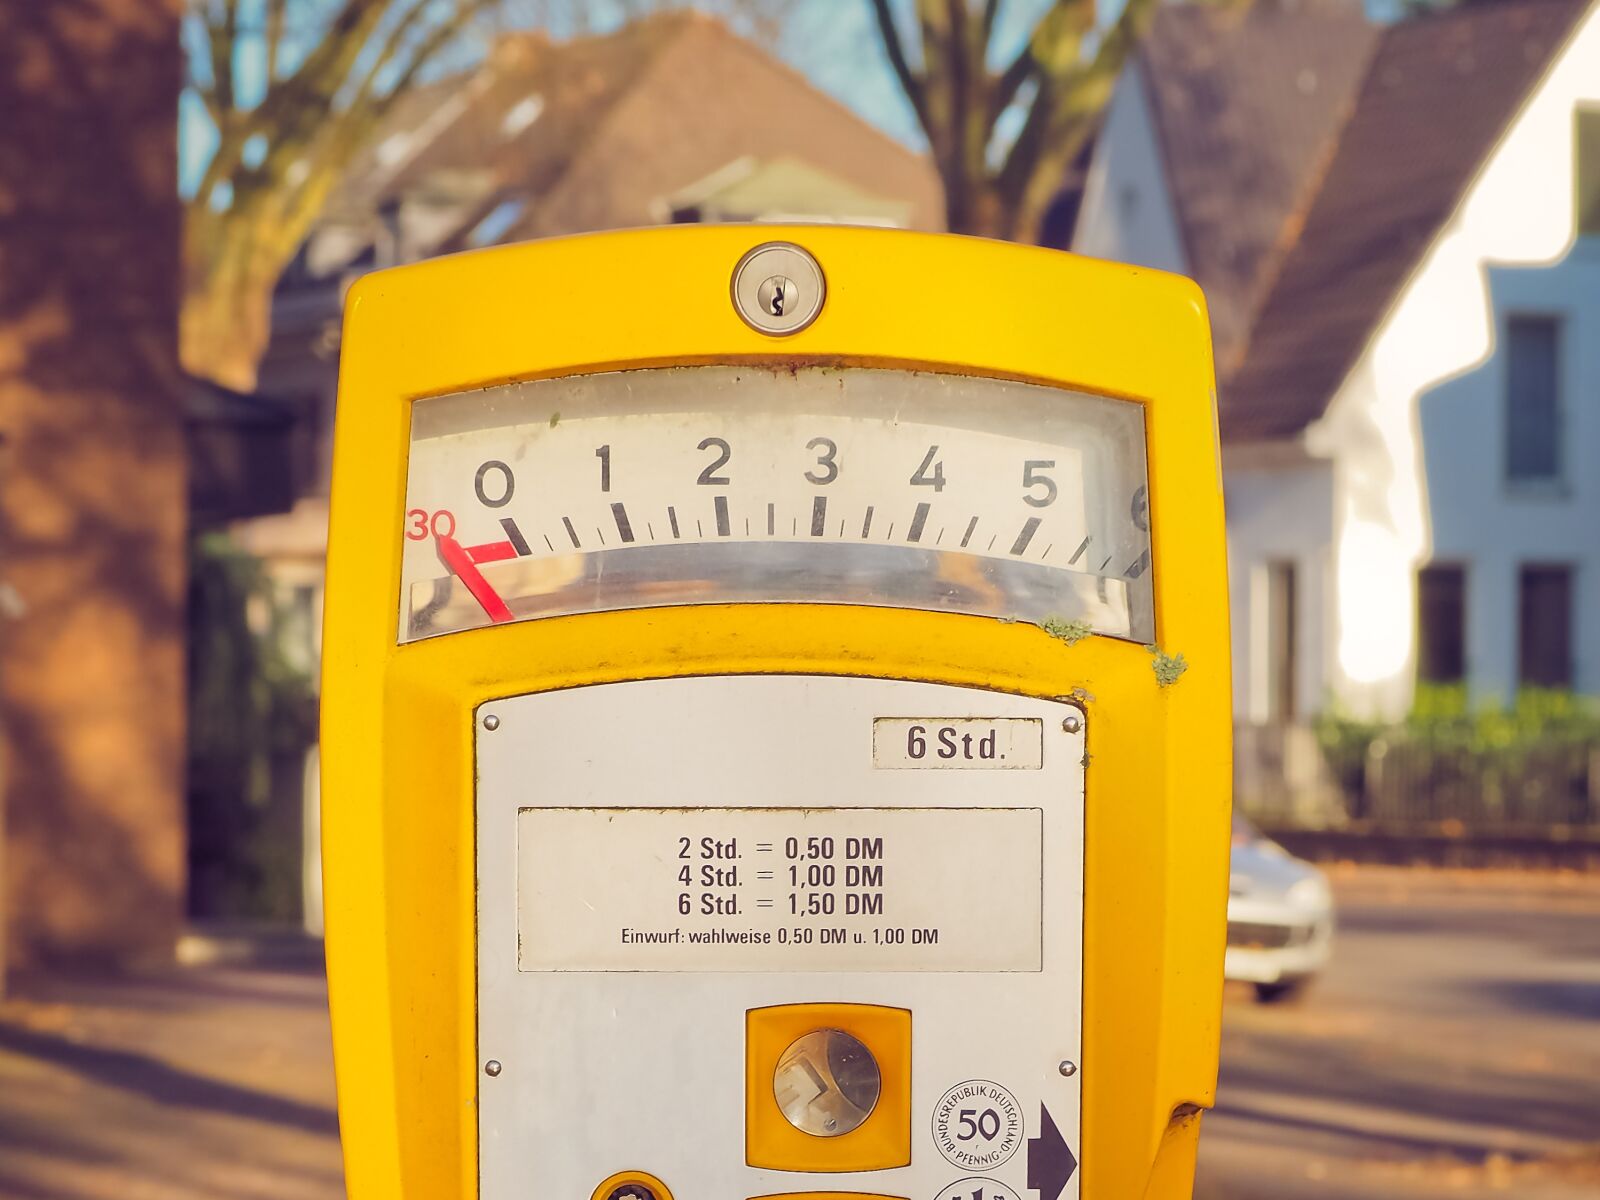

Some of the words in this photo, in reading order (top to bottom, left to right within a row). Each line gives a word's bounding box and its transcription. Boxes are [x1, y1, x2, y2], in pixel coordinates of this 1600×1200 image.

[406, 508, 456, 540] 30
[474, 460, 515, 509] 0
[595, 444, 611, 492] 1
[696, 437, 732, 485] 2
[803, 437, 839, 485] 3
[909, 444, 946, 493] 4
[1022, 460, 1058, 508] 5
[907, 725, 927, 760] 6
[937, 726, 1006, 760] Std.
[678, 836, 692, 860] 2
[700, 836, 743, 861] Std.
[785, 836, 835, 862] 0,50
[845, 837, 883, 860] DM
[678, 864, 693, 887] 4
[700, 864, 743, 888] Std.
[788, 864, 836, 889] 1,00
[845, 865, 883, 888] DM
[678, 892, 692, 916] 6
[700, 892, 743, 916] Std.
[788, 892, 835, 918] 1,50
[845, 893, 883, 916] DM
[621, 927, 685, 945] Einwurf:
[688, 928, 771, 945] wahlweise
[777, 927, 813, 947] 0,50
[820, 928, 847, 945] DM
[853, 931, 867, 945] u.
[872, 928, 905, 947] 1,00
[911, 928, 939, 945] DM
[937, 1085, 987, 1153] BUNDESREPUBLIK
[988, 1088, 1018, 1152] DEUTSCHLAND
[956, 1108, 1001, 1142] 50
[955, 1150, 1000, 1166] PFENNIG
